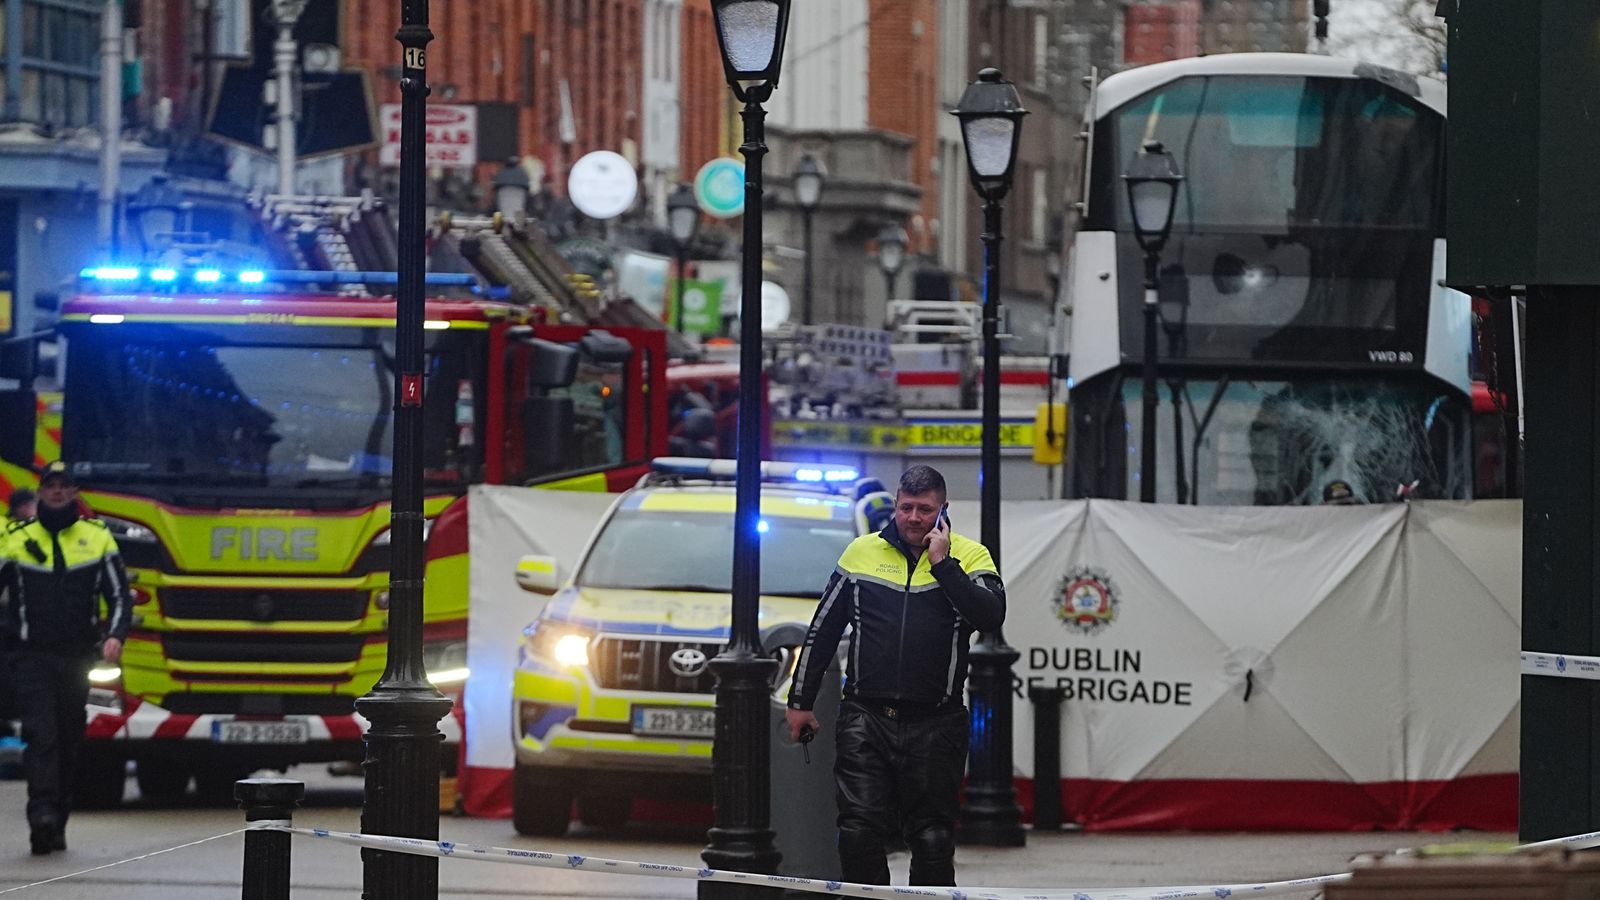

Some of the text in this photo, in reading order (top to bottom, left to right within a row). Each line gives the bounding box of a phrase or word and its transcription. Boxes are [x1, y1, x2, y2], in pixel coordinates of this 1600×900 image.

[408, 49, 426, 67] 16
[1368, 350, 1413, 362] VWD 80
[210, 527, 319, 561] FIRE
[1029, 647, 1141, 673] DUBLIN
[1057, 676, 1192, 706] BRIGADE
